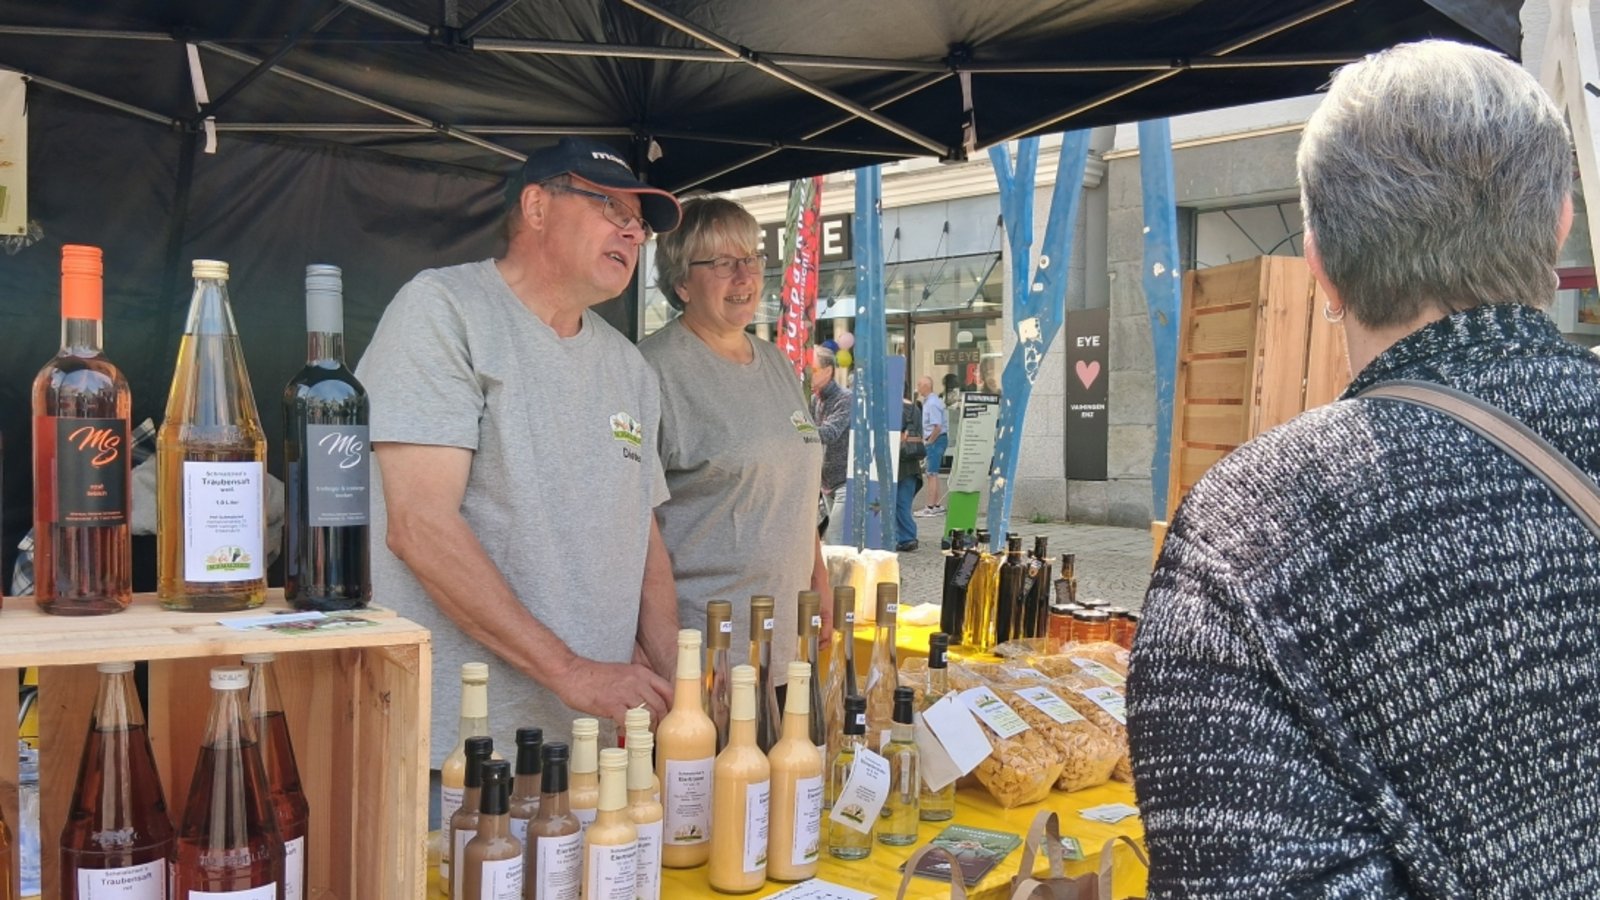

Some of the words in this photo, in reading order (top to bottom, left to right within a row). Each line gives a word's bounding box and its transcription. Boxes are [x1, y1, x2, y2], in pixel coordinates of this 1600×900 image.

[1076, 335, 1101, 347] EYE
[935, 352, 956, 361] EYE
[959, 351, 979, 360] EYE
[201, 477, 250, 486] Traubensaft
[101, 872, 152, 886] Traubensaft
